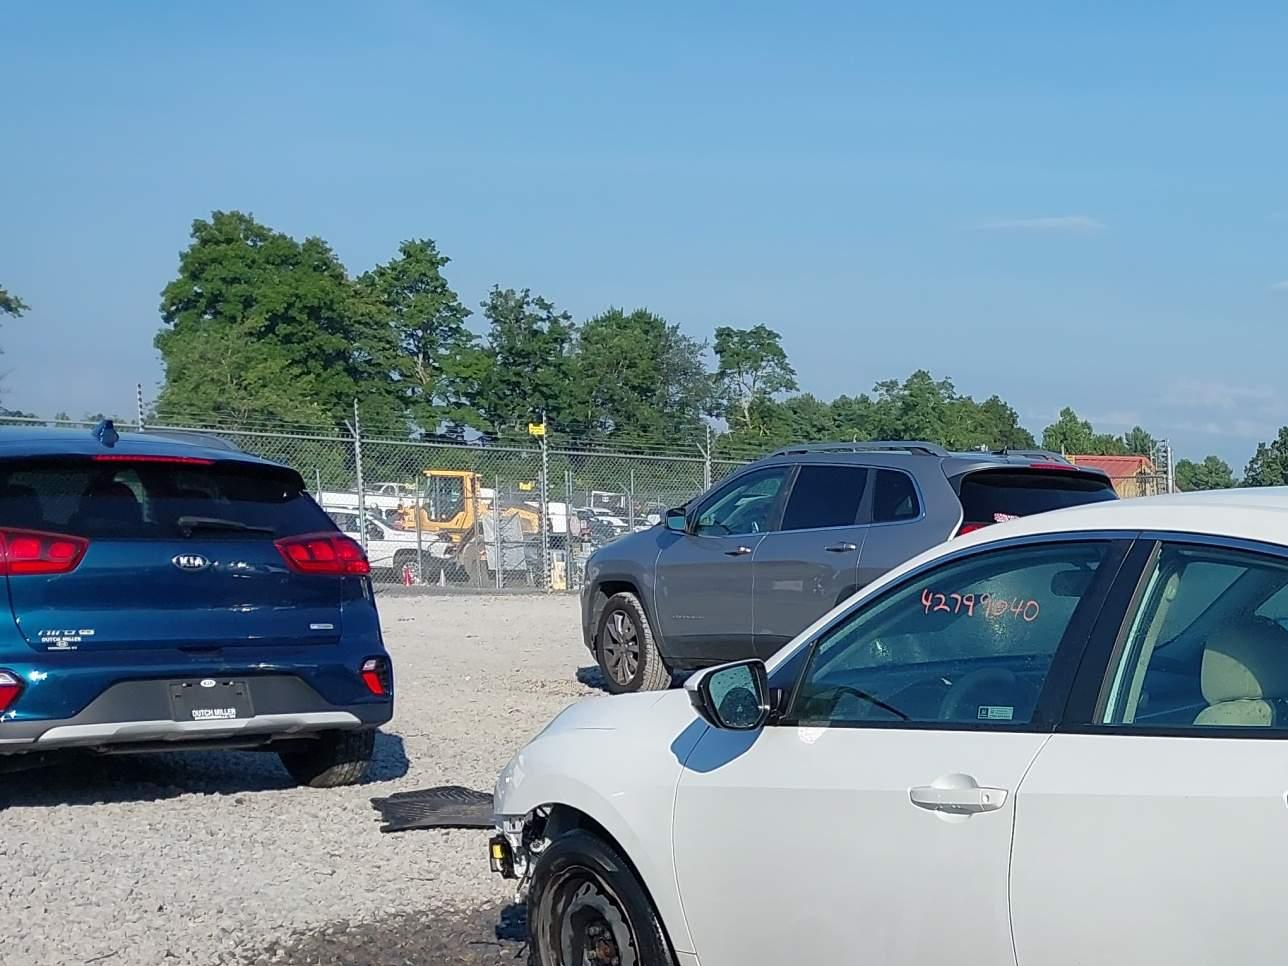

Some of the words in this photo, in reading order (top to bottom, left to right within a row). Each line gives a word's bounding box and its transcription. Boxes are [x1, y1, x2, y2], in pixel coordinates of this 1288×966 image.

[921, 588, 1040, 622] 42799040
[192, 709, 213, 718] DUTCH
[213, 708, 236, 717] MILLER
